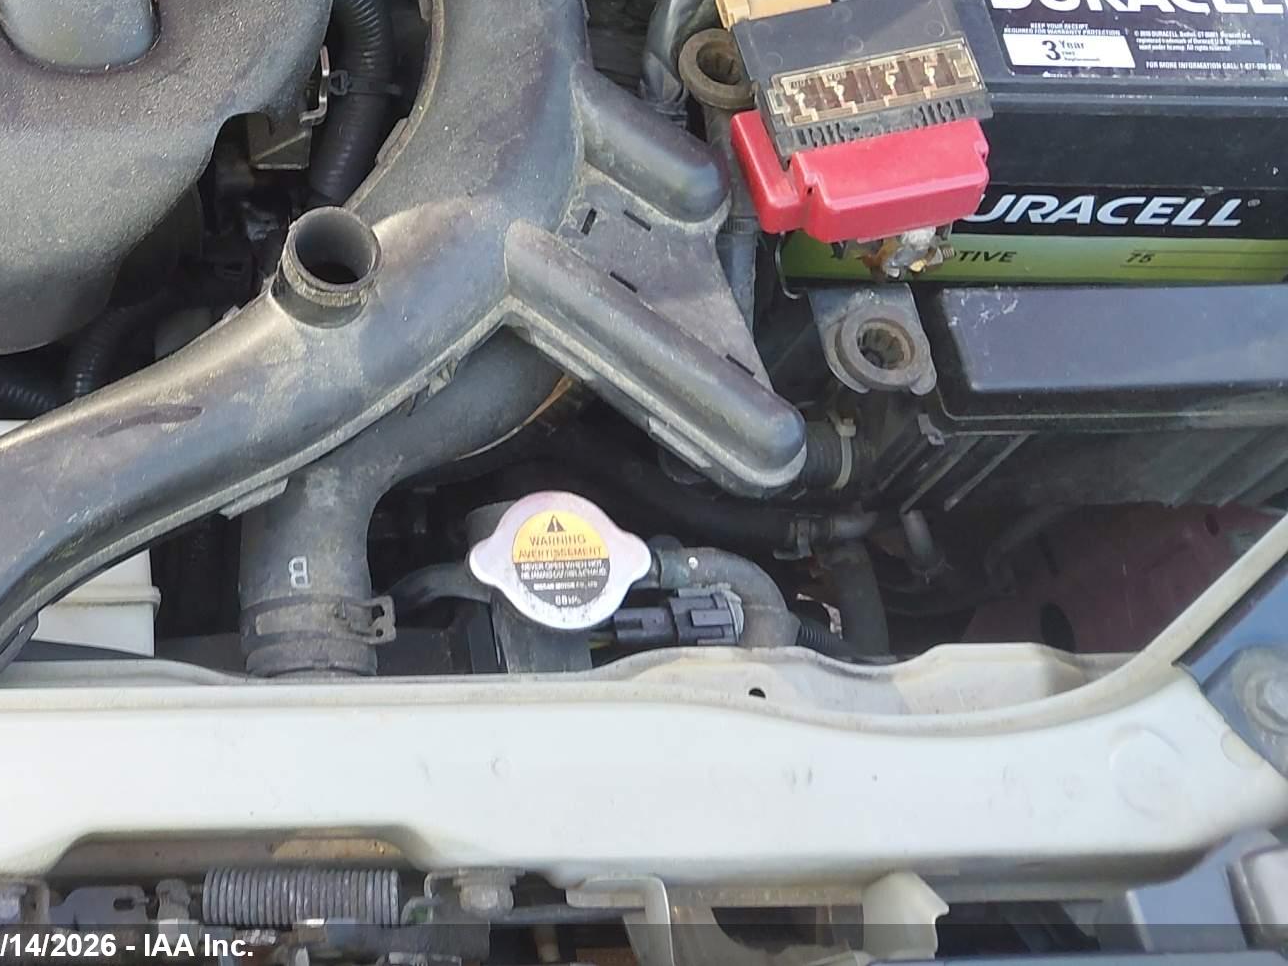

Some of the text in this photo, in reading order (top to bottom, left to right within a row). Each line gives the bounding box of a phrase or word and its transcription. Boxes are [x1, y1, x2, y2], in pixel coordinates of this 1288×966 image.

[1041, 40, 1062, 61] 3
[1058, 39, 1085, 49] Year
[1145, 61, 1159, 69] FOR
[1158, 61, 1177, 69] MORE
[1178, 61, 1222, 70] INFORMATION
[964, 194, 1242, 227] URACELL
[529, 534, 587, 547] WARNING
[518, 545, 602, 560] AVERTISSEMENT
[520, 562, 544, 571] NEVER
[544, 561, 565, 571] OPEN
